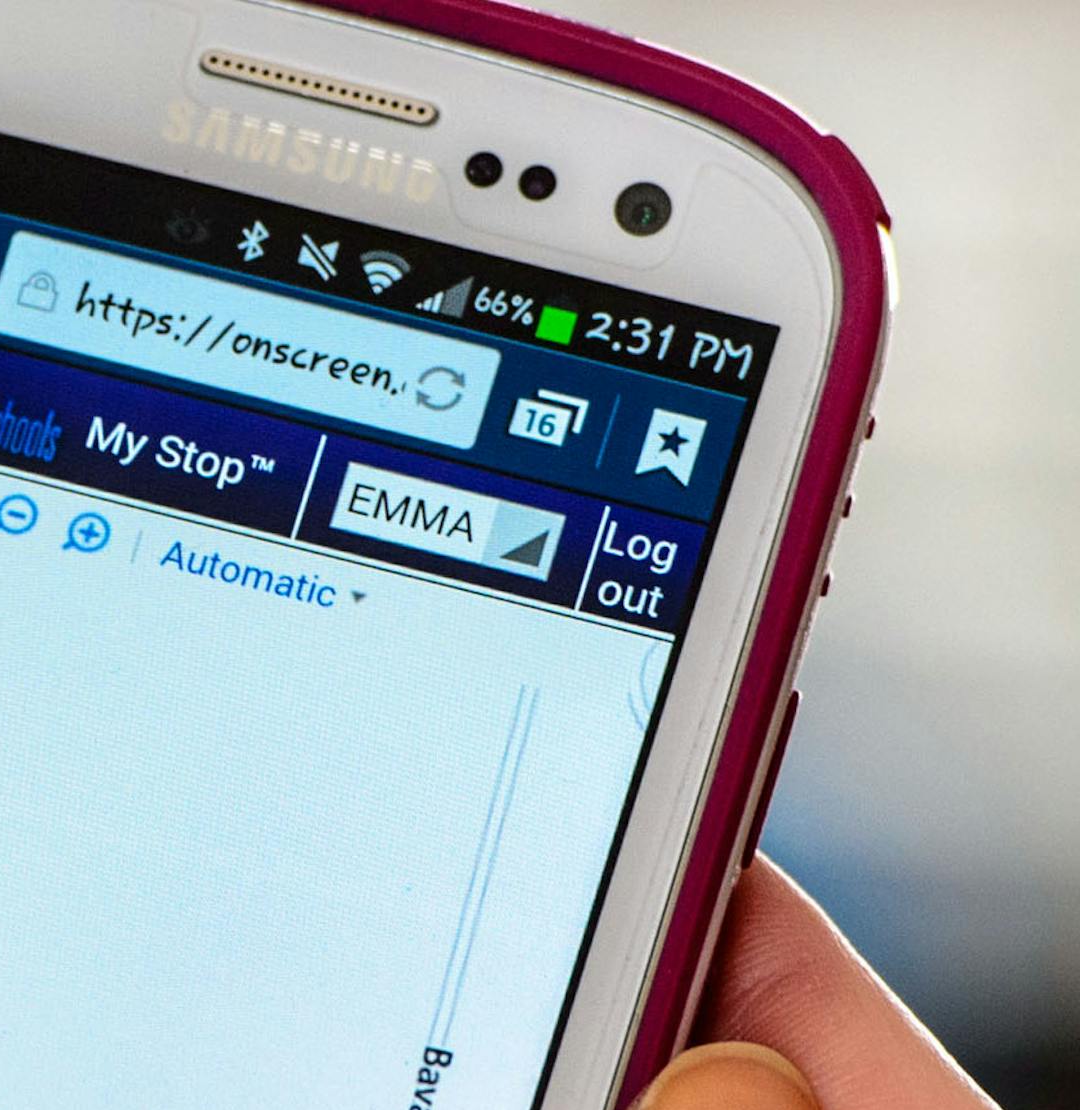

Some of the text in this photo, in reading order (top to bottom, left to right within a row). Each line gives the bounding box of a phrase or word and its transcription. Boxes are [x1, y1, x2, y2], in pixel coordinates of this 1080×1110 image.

[161, 100, 440, 203] SAMSUNG
[474, 286, 534, 325] 66%
[75, 281, 406, 396] https://onscreen.
[585, 312, 754, 380] 2:31 PM
[85, 416, 149, 466] My
[524, 408, 556, 436] 16
[347, 482, 474, 543] EMMA
[160, 540, 337, 608] Automatic
[602, 520, 678, 574] Log
[597, 580, 665, 618] out
